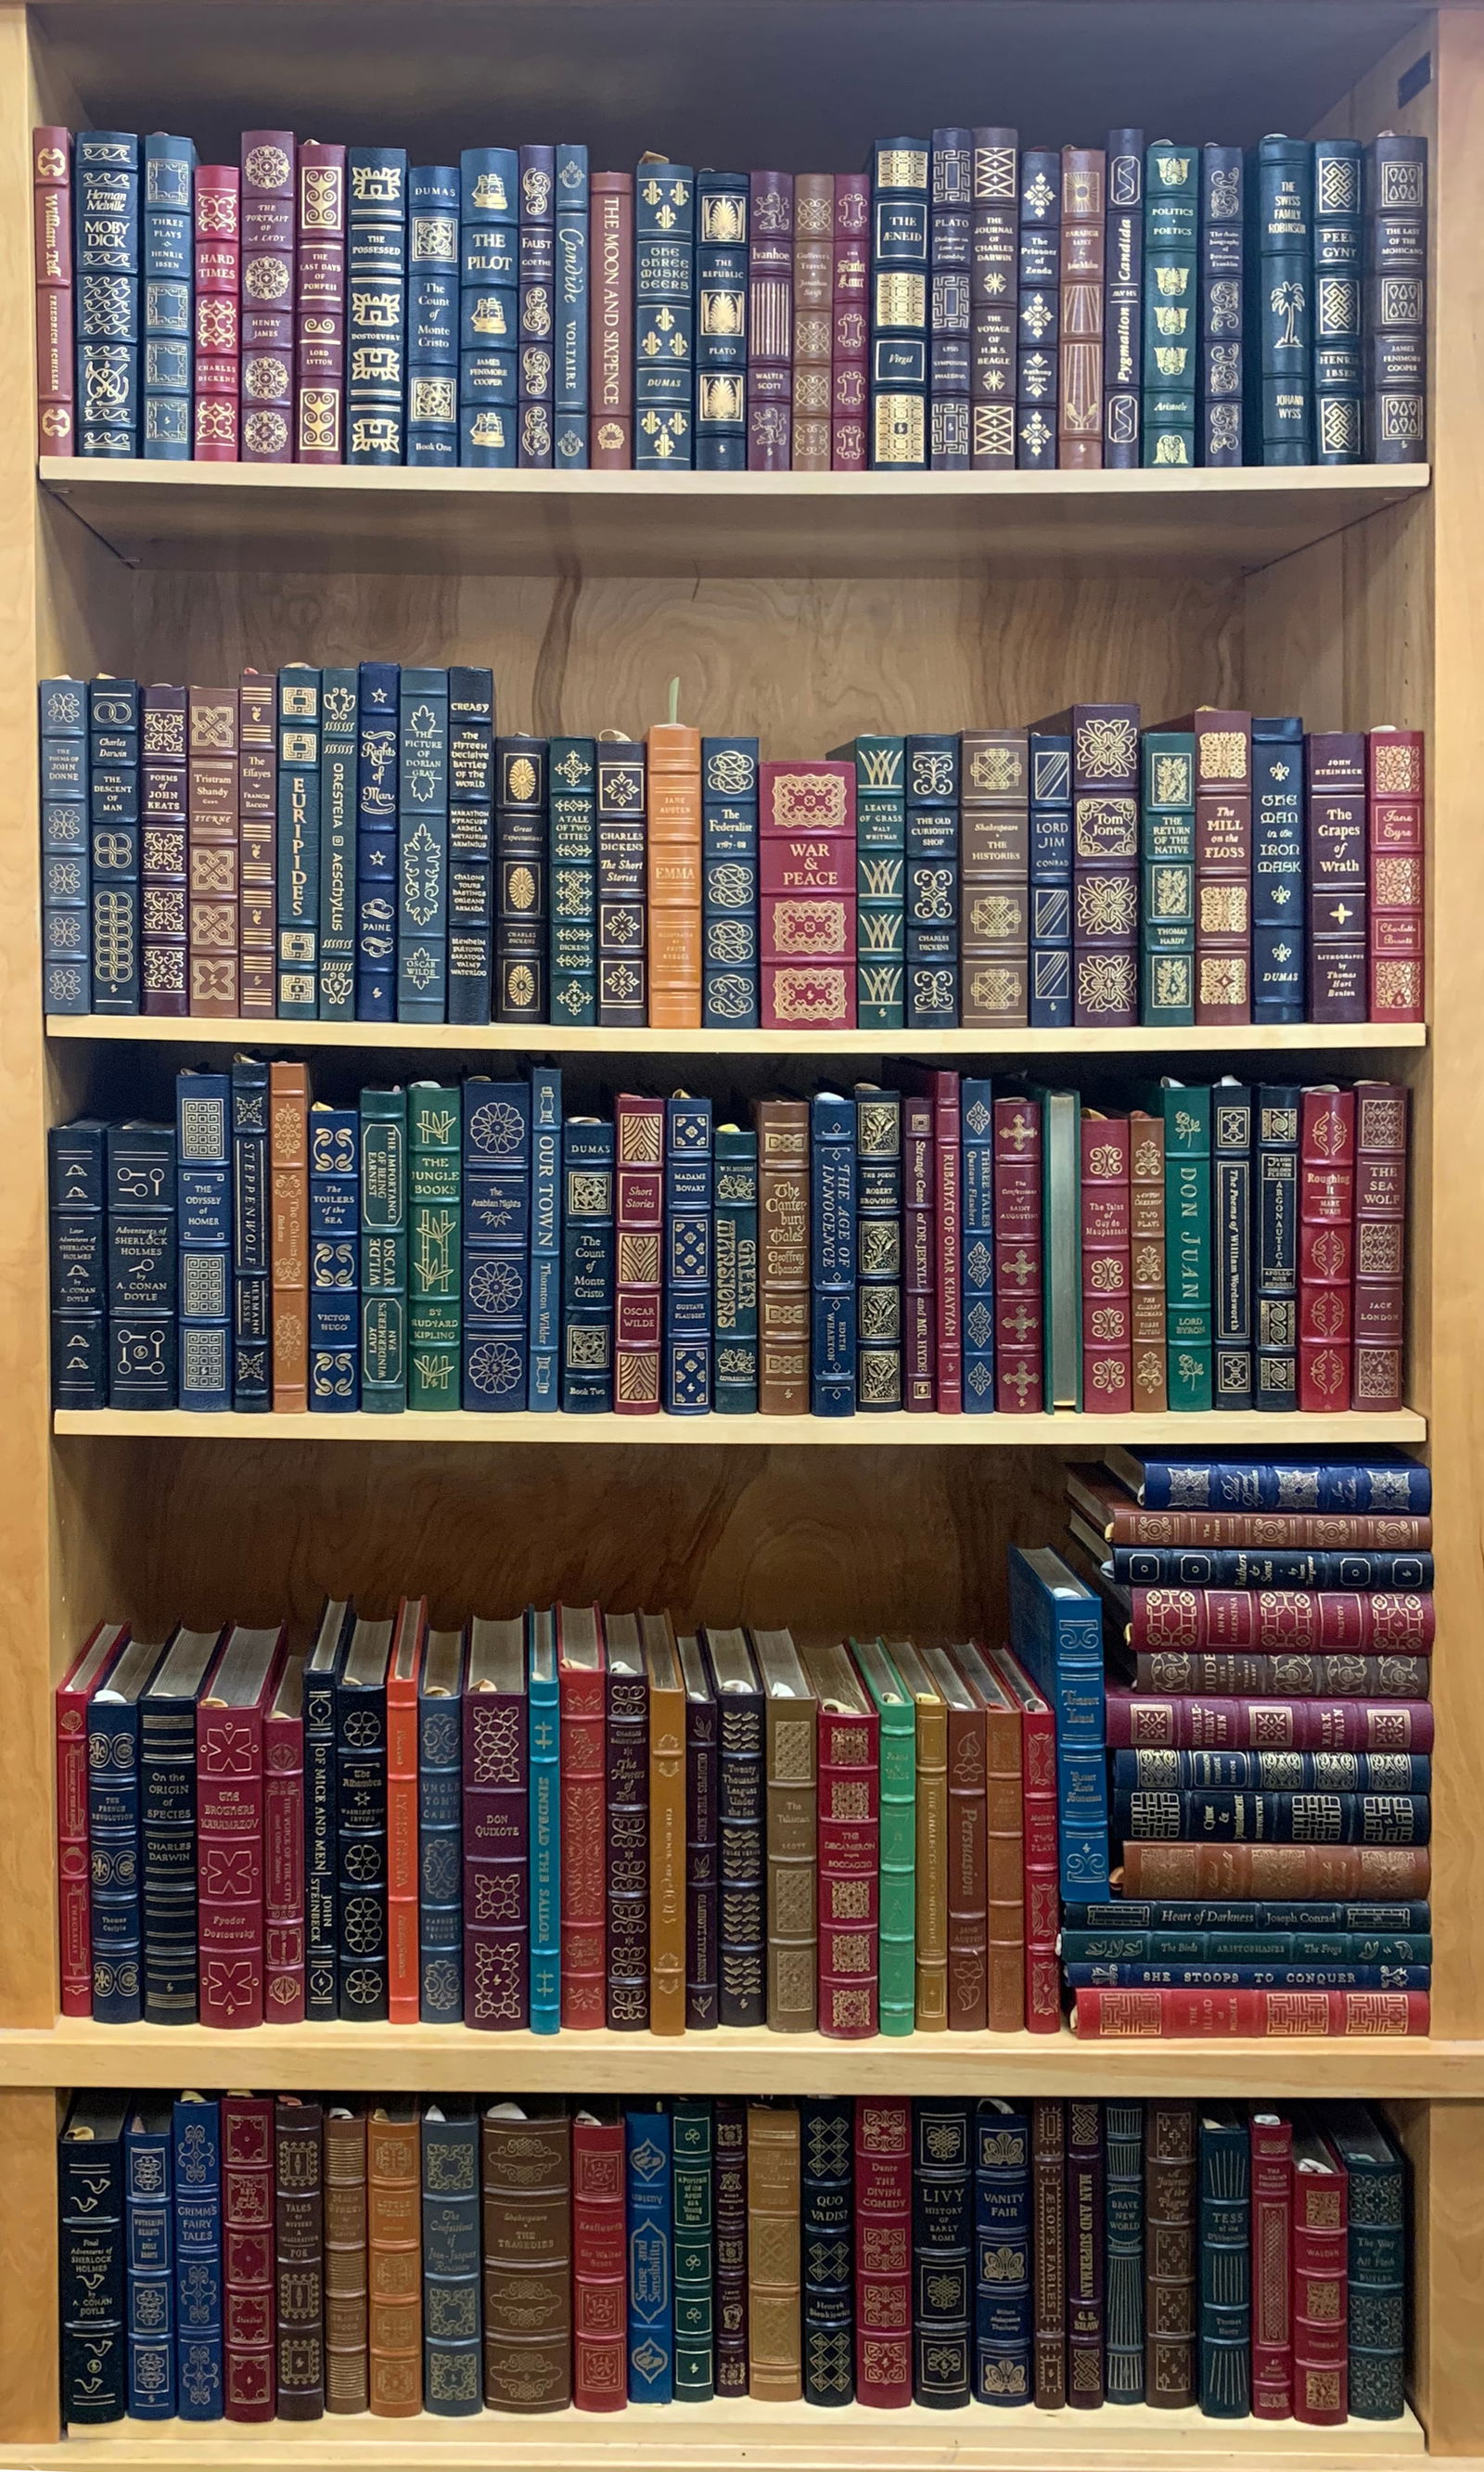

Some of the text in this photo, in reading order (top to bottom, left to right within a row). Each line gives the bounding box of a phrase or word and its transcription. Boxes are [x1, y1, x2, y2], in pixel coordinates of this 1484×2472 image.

[86, 189, 127, 201] Herman
[415, 187, 455, 197] DUMAS
[87, 199, 125, 212] Melville
[1152, 208, 1194, 217] POLITICS
[1273, 209, 1301, 221] FAMILY
[84, 221, 130, 235] MOBY
[151, 218, 184, 227] THREE
[154, 229, 182, 239] PLAYS
[974, 225, 1014, 234] JOURNAL
[1153, 226, 1192, 236] POETICS
[87, 234, 126, 248] DICK
[472, 234, 506, 249] THE
[883, 231, 922, 242] ÆNEID
[522, 238, 552, 250] FAUST
[352, 246, 401, 255] POSSESSED
[752, 246, 790, 260] Ivanhoe
[1119, 219, 1131, 281] Candida
[45, 251, 61, 277] Tell
[200, 254, 235, 265] HARD
[467, 257, 513, 271] PILOT
[198, 267, 236, 279] TIMES
[702, 269, 744, 279] REPUBLIC
[603, 198, 620, 405] THE MOON AND SIXPENCE
[558, 228, 584, 391] Candide VOLTAIRE
[254, 329, 278, 338] JAMES
[49, 295, 58, 391] FRIEDRICH SCHILLER
[1118, 307, 1131, 383] Pygmalion
[709, 347, 736, 355] PLATO
[889, 353, 914, 364] Virgil
[647, 378, 682, 388] DUMAS
[1279, 408, 1302, 419] WYSS
[99, 737, 126, 748] Charles
[98, 749, 127, 758] Darwin
[194, 774, 231, 785] Tristram
[94, 785, 132, 793] DESCENT
[197, 786, 228, 798] Shandy
[148, 790, 178, 800] JOHN
[363, 788, 395, 803] Man
[103, 803, 122, 812] MAN
[147, 801, 180, 811] KEATS
[864, 804, 898, 813] LEAVES
[860, 814, 902, 823] OF GRASS
[1096, 813, 1123, 826] Tom
[709, 819, 752, 833] Federalist
[1036, 823, 1068, 834] LORD
[1093, 824, 1126, 837] Jones
[1153, 826, 1191, 835] RETURN
[1208, 820, 1244, 831] MILL
[558, 832, 589, 841] CITIES
[600, 832, 644, 841] CHARLES
[911, 827, 954, 837] CURIOSITY
[1318, 825, 1361, 839] Grapes
[291, 778, 307, 916] EURIPIDES
[600, 843, 644, 852] DICKENS
[1038, 838, 1065, 848] JIM
[789, 844, 830, 857] WAR
[1204, 847, 1245, 858] FLOSS
[804, 859, 818, 871] &
[1320, 860, 1360, 873] Wrath
[607, 872, 637, 883] Stories
[656, 867, 695, 879] EMMA
[783, 872, 838, 886] PEACE
[363, 923, 390, 931] PAINE
[411, 1172, 460, 1182] JUNGLE
[1307, 1173, 1350, 1185] Roughing
[414, 1185, 456, 1196] BOOKS
[539, 1136, 554, 1248] OUR TOWN
[675, 1185, 705, 1193] BOVARY
[186, 1196, 221, 1205] ODYSSEY
[246, 1143, 255, 1266] STEPPENWOLF
[313, 1195, 354, 1204] TOILERS
[1364, 1195, 1401, 1205] WOLF
[822, 1164, 835, 1269] INNOCENCE
[944, 1216, 954, 1233] OF
[1180, 1167, 1202, 1299] DON JUAN
[115, 1236, 168, 1245] SHERLOCK
[121, 1247, 162, 1256] HOLMES
[944, 1236, 954, 1275] OMAR
[369, 1238, 381, 1287] WILDE
[383, 1238, 396, 1287] OSCAR
[117, 1282, 167, 1290] A. CONAN
[123, 1293, 158, 1301] DOYLE
[539, 1262, 551, 1344] Thornton Wilder
[1321, 1713, 1331, 1747] MARK
[1333, 1709, 1344, 1748] TWAIN
[148, 1785, 189, 1796] ORIGIN
[147, 1810, 191, 1820] SPECIES
[315, 1747, 326, 1873] OF MICE AND MEN
[486, 1815, 508, 1824] DON
[475, 1826, 519, 1837] QUIXOTE
[148, 1851, 189, 1861] DARWIN
[961, 1807, 978, 1897] Persuasion
[539, 1777, 550, 1943] SINDBAD THE SAILOR
[311, 1878, 320, 1941] STEINBECK
[1162, 1910, 1254, 1924] Heart of Darkness
[1265, 1912, 1337, 1925] Joseph Conrad
[1144, 1972, 1356, 1983] SHE STOOPS TO CONQUER
[923, 2188, 966, 2203] LIVY
[984, 2193, 1025, 2204] VANITY
[816, 2196, 843, 2207] QUO
[863, 2198, 906, 2209] COMEDY
[177, 2206, 218, 2216] GRIMM'S
[811, 2209, 848, 2221] VADIS?
[991, 2206, 1017, 2216] FAIR
[1212, 2212, 1244, 2222] TESS
[183, 2219, 211, 2229] FAIRY
[1109, 2222, 1141, 2231] WORLD
[182, 2231, 213, 2241] TALES
[1080, 2174, 1093, 2299] MAN AND SUPERMAN
[290, 2248, 308, 2257] POE
[1306, 2248, 1339, 2257] WALDEN
[635, 2239, 648, 2301] Sense and
[649, 2240, 661, 2302] Sensibility
[1045, 2254, 1055, 2309] FABLES
